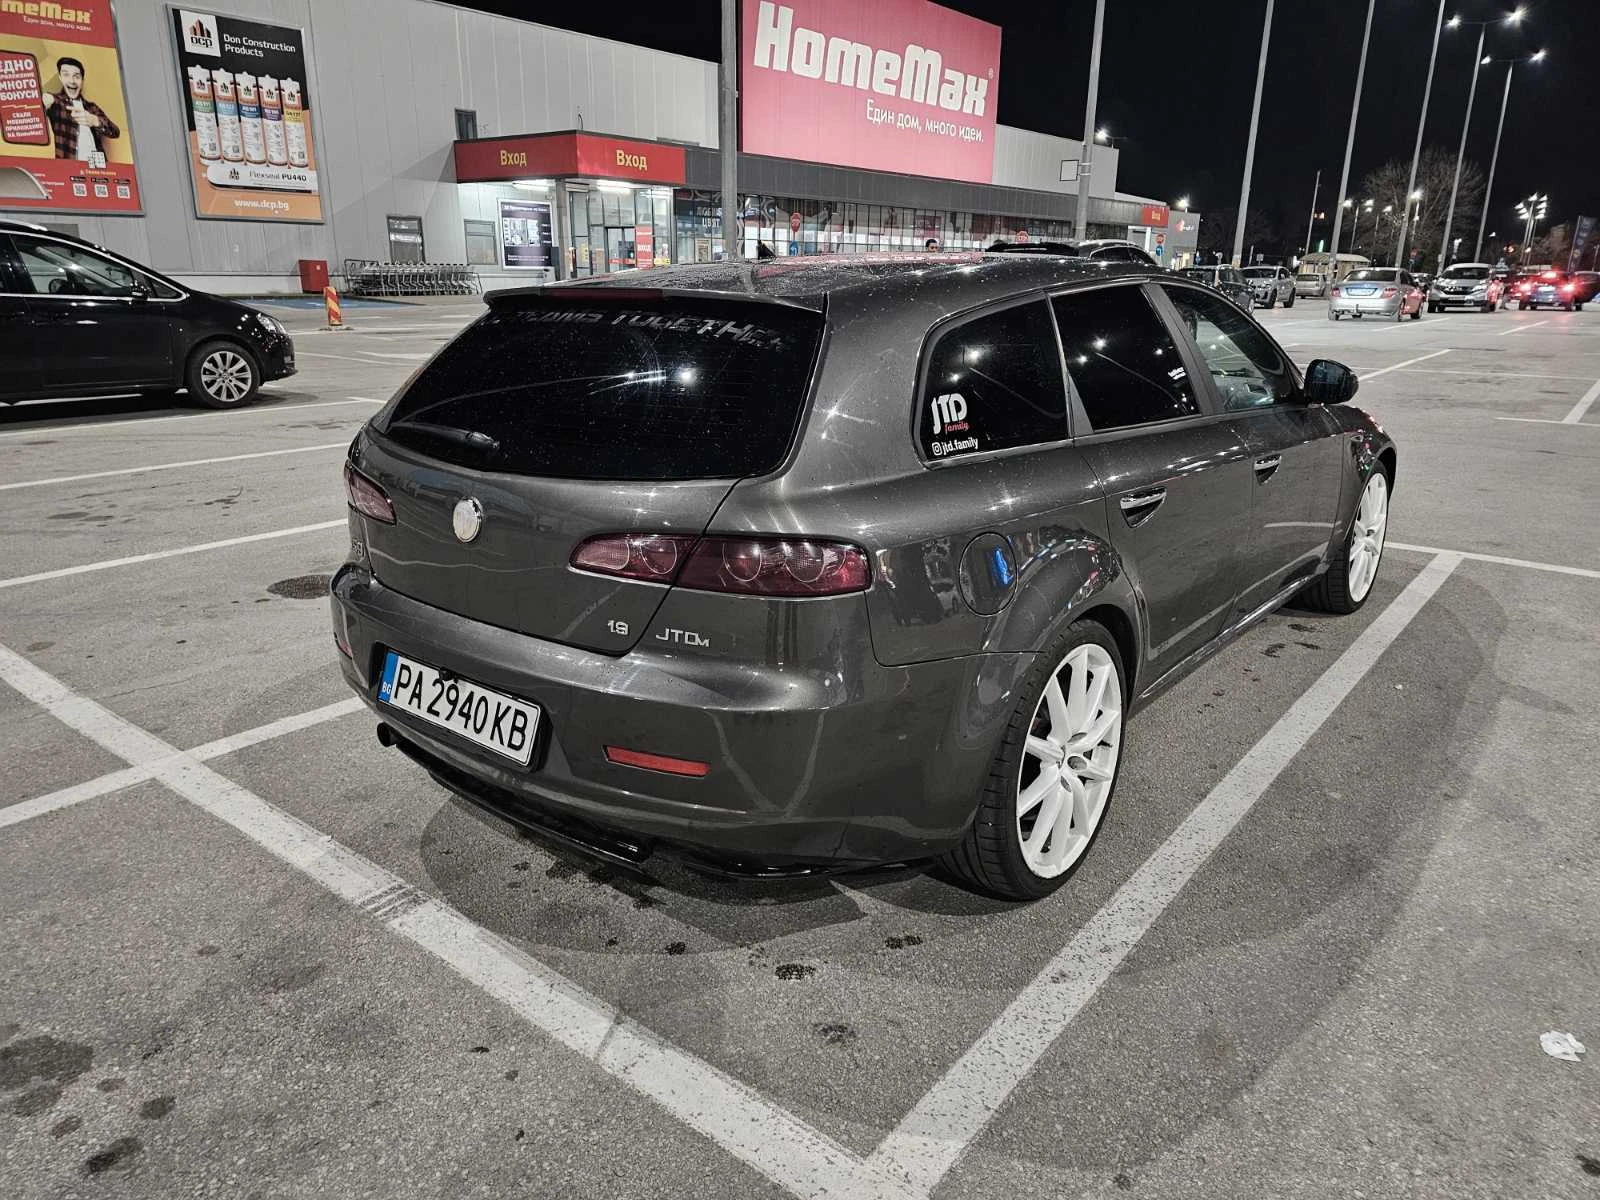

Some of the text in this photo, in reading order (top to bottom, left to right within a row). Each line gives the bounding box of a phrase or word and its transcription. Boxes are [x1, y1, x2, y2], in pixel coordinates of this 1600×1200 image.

[0, 0, 91, 24] meMax
[224, 34, 296, 53] Don Construction
[225, 43, 264, 57] Products
[753, 1, 988, 117] HomeMax
[866, 99, 984, 143] Един дом, много идеи.
[500, 150, 527, 167] Вход
[616, 149, 648, 171] Вход
[931, 392, 968, 435] JTD
[382, 682, 392, 694] BG
